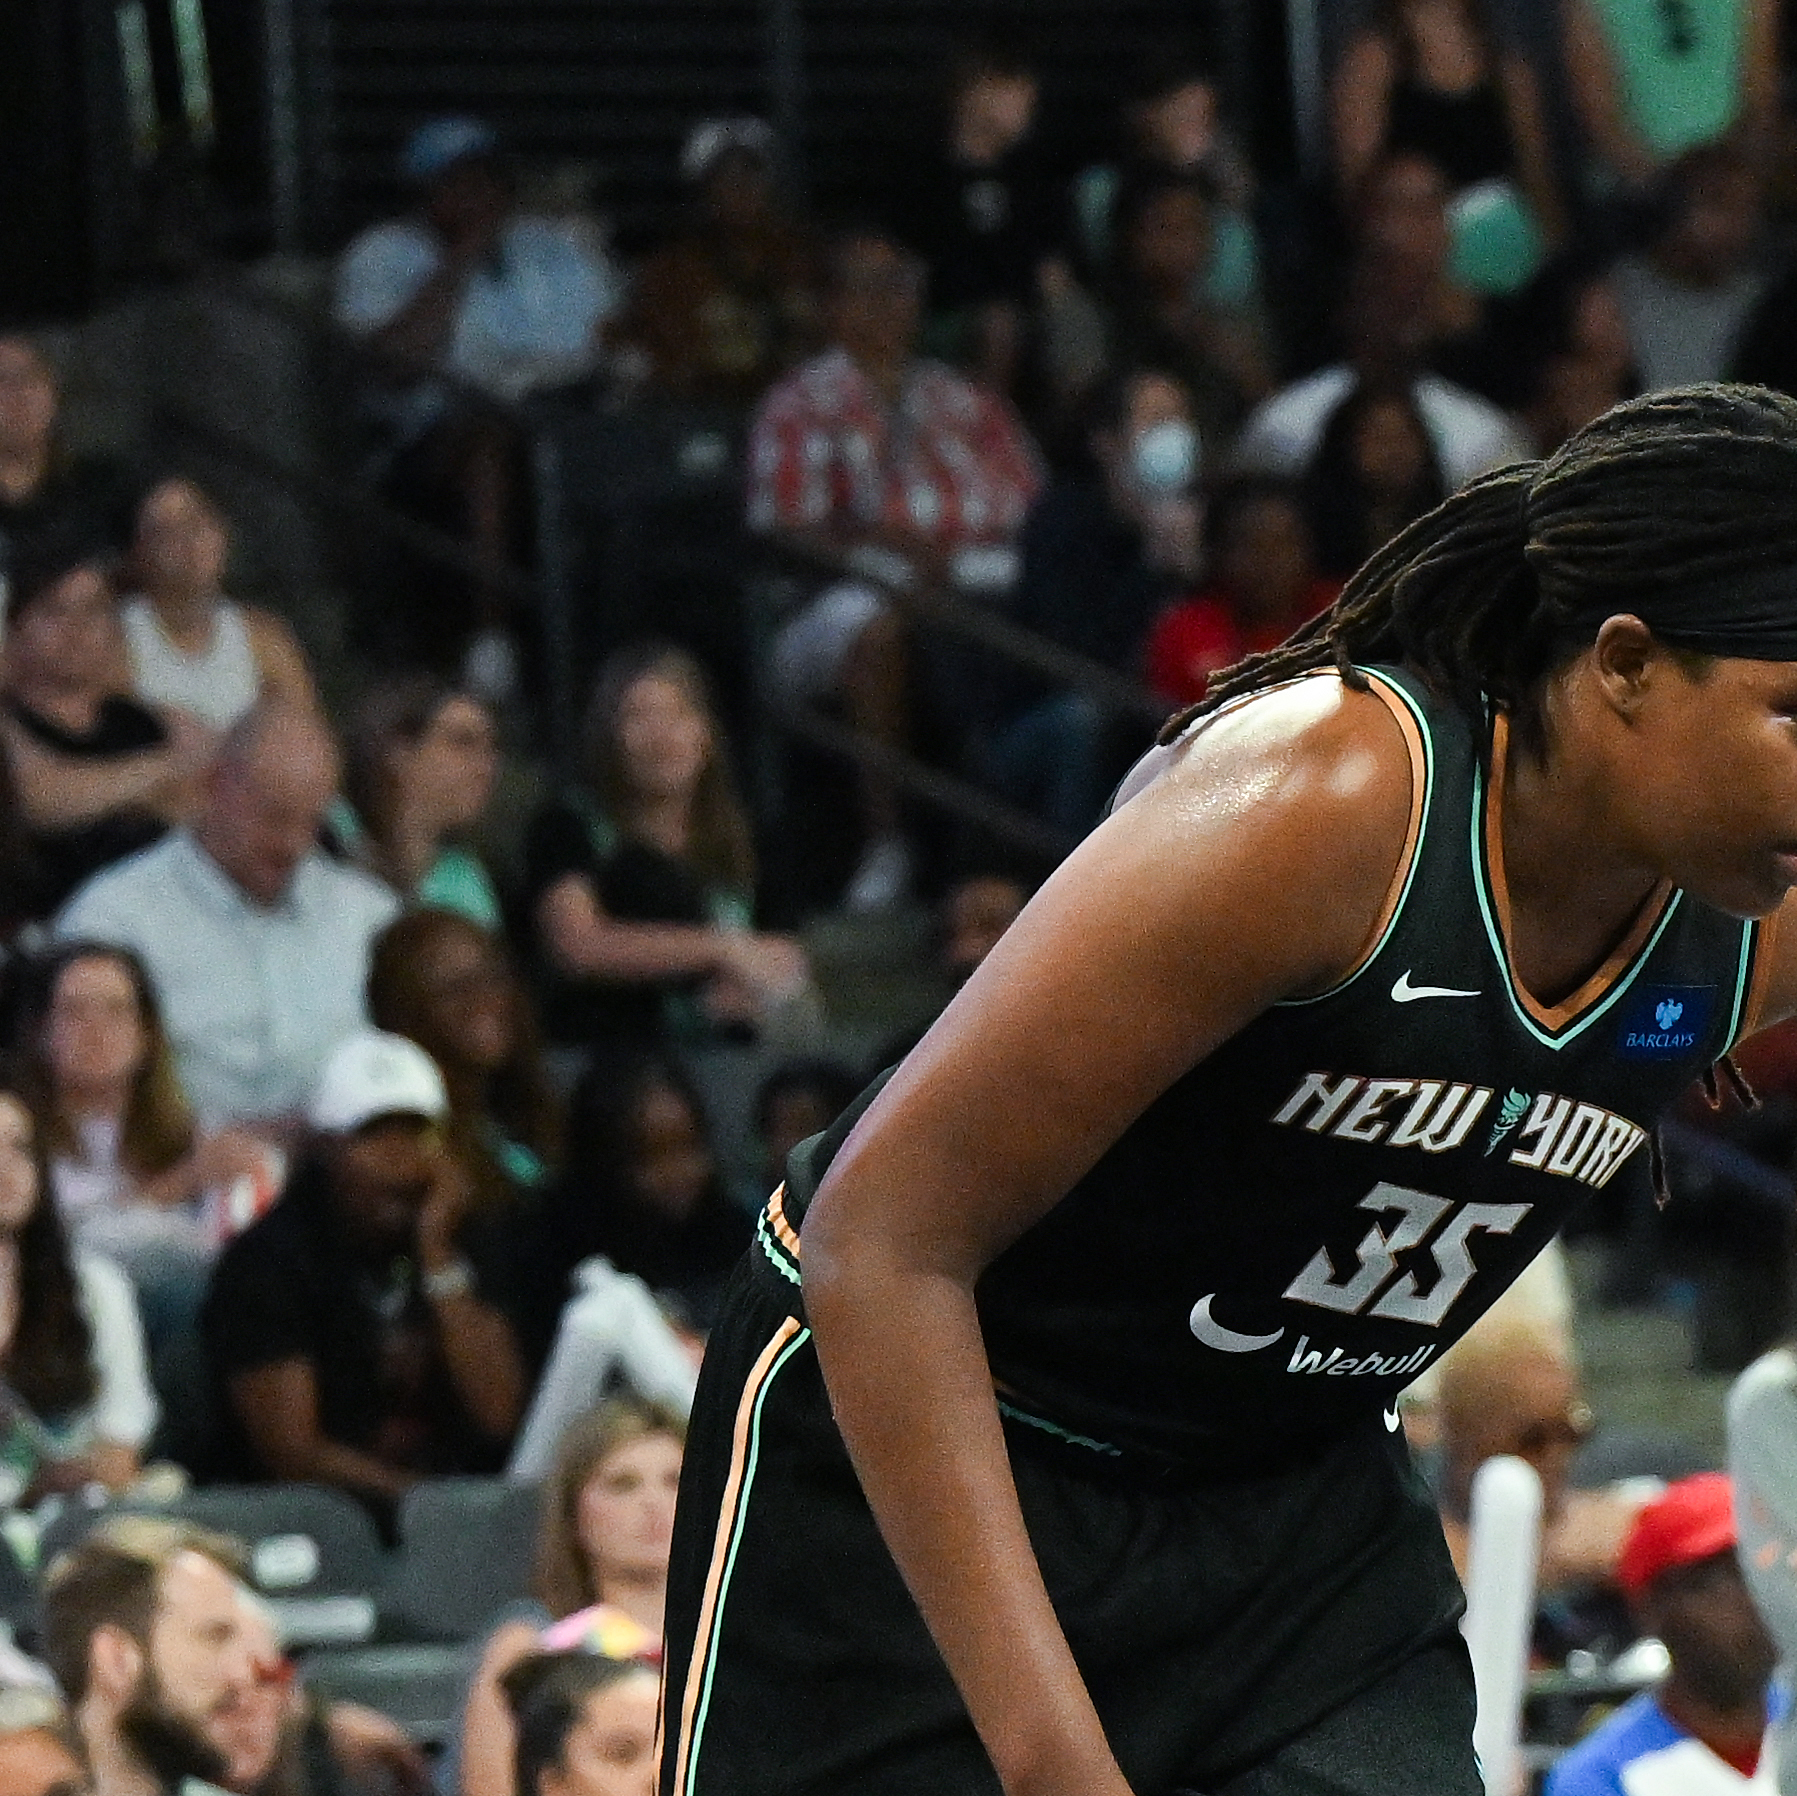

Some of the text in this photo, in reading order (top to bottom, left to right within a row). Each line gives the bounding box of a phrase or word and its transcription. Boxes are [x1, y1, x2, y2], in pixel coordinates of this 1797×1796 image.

[1625, 1032, 1696, 1048] BARCLAYS
[1269, 1070, 1495, 1155] NEW
[1280, 1180, 1535, 1328] 35
[1285, 1334, 1437, 1377] Webull
